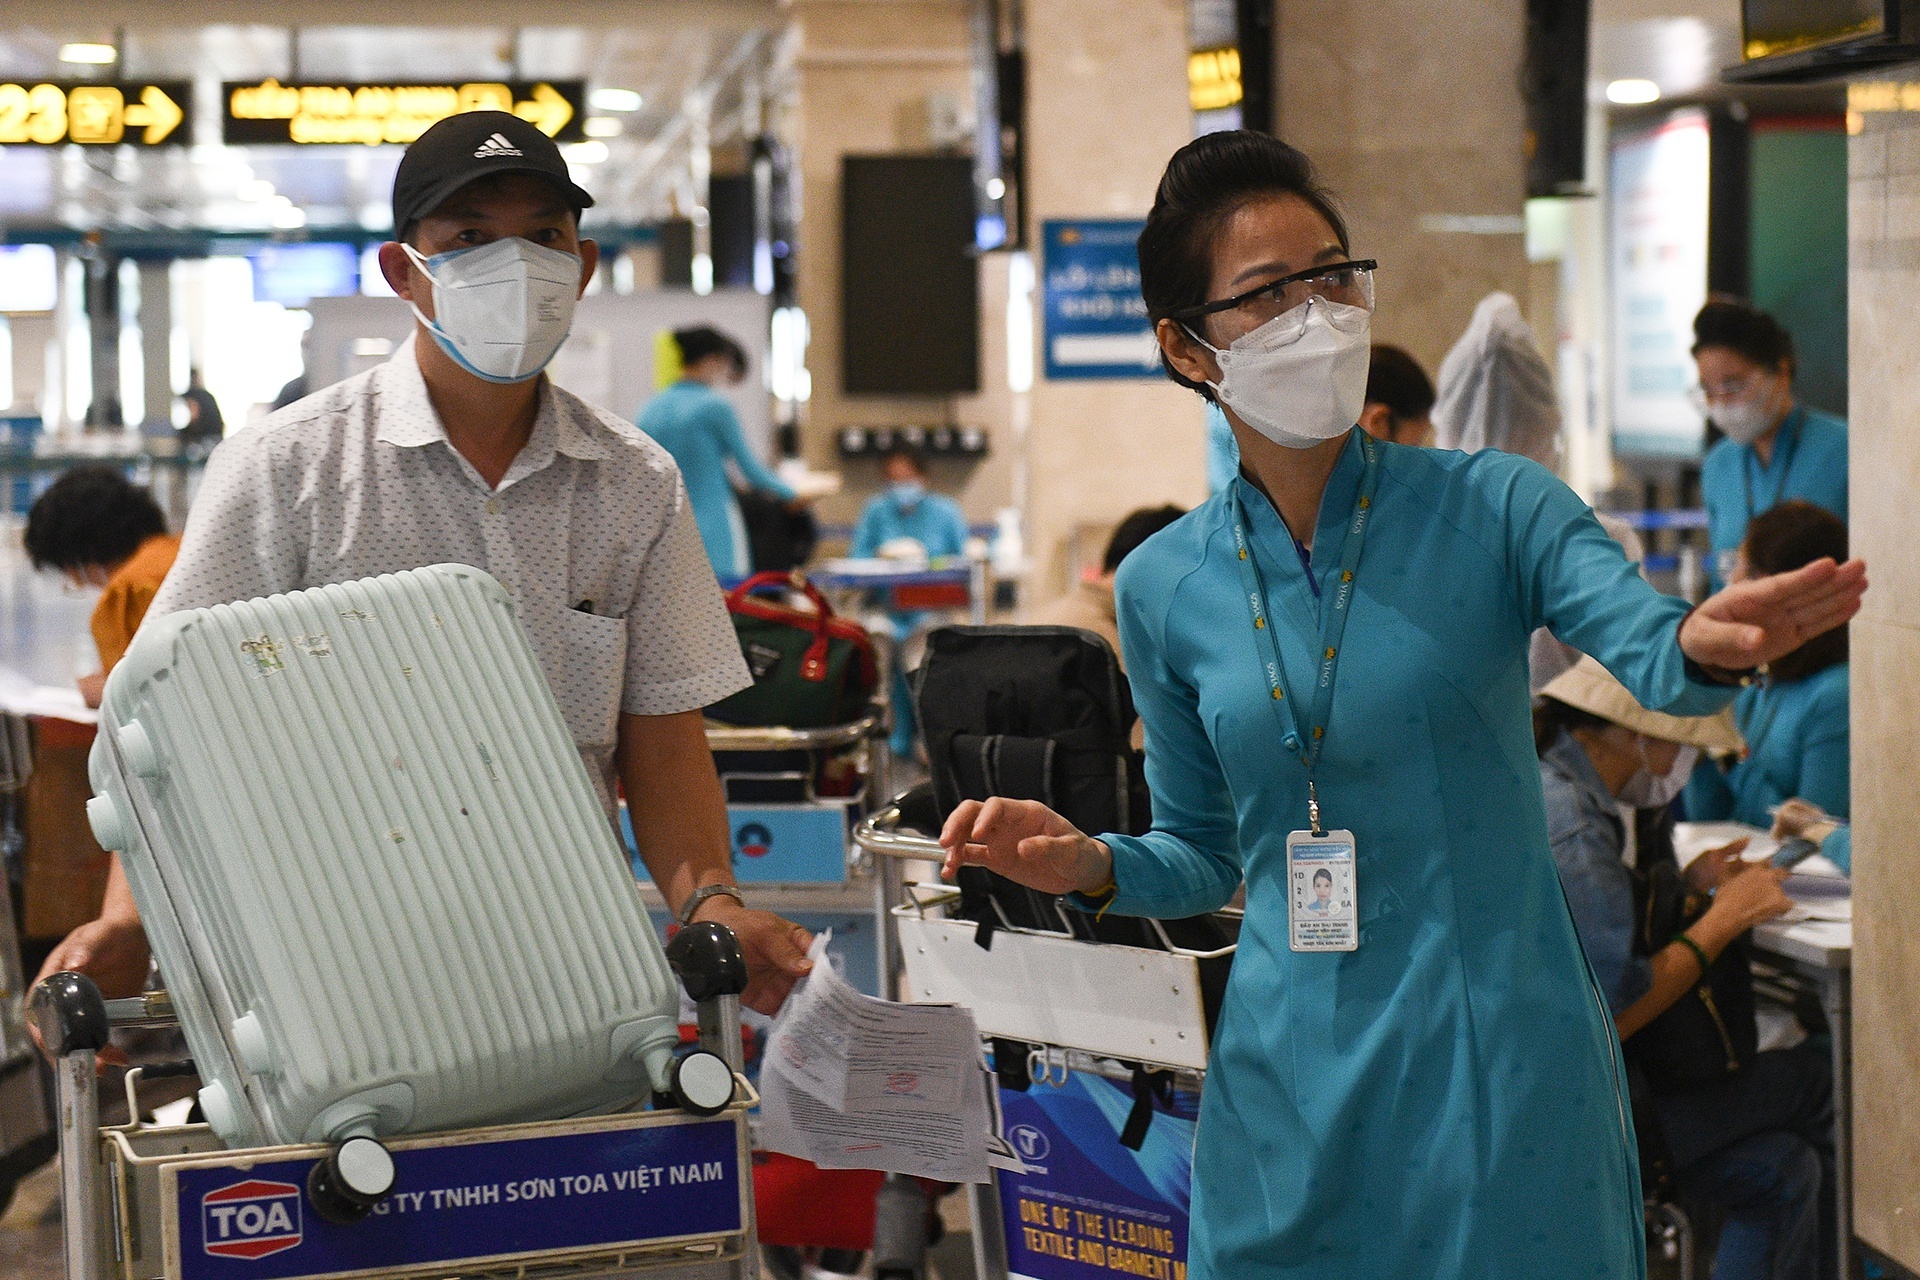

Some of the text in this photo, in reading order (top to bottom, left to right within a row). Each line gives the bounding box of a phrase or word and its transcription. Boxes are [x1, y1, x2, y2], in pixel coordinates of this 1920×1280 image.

[473, 148, 523, 158] adidas
[394, 1190, 427, 1212] TY
[429, 1184, 500, 1210] TNHH
[505, 1177, 556, 1202] SƠN
[560, 1173, 609, 1196] TOA
[612, 1165, 664, 1194] VIỆT
[669, 1161, 723, 1185] NAM
[210, 1201, 294, 1238] TOA
[1019, 1198, 1049, 1227] ONE
[1052, 1206, 1070, 1231] OF
[1075, 1210, 1105, 1238] THE
[1108, 1217, 1174, 1254] LEADING
[1023, 1226, 1076, 1260] TEXTILE
[1078, 1240, 1105, 1267] AND
[1107, 1246, 1170, 1280] GARMENT
